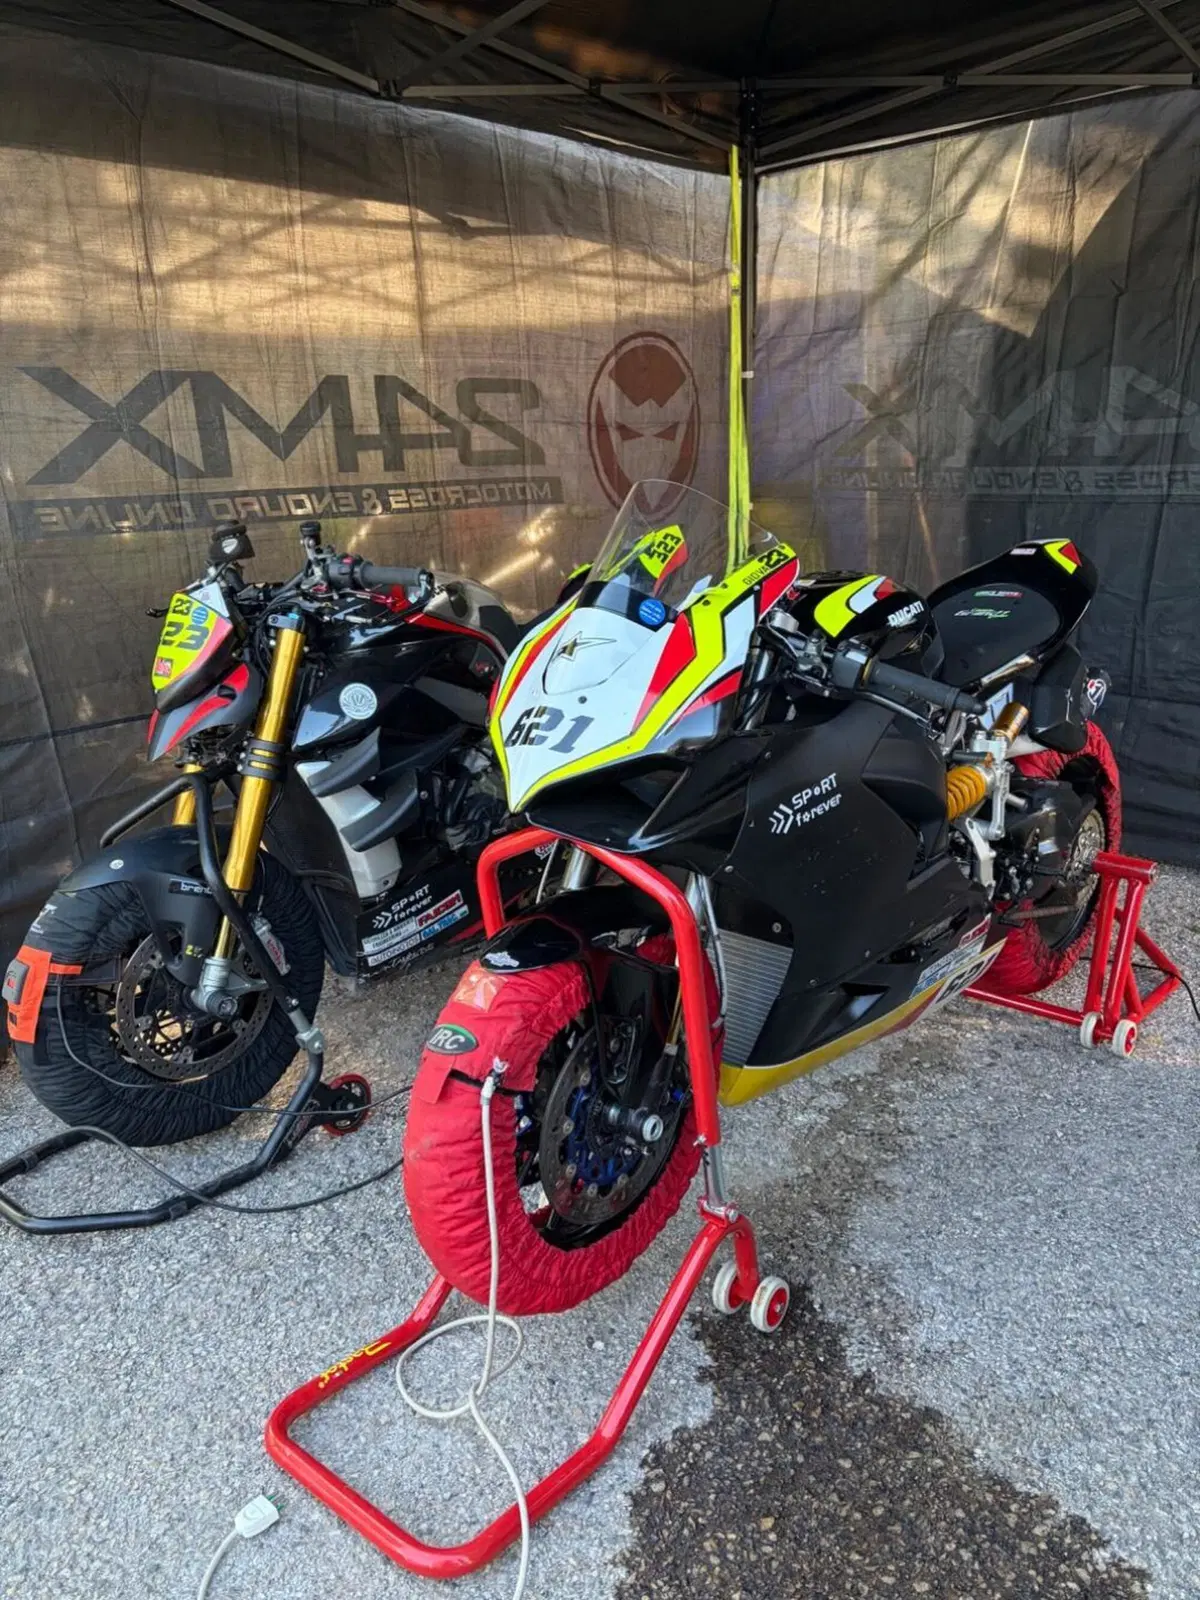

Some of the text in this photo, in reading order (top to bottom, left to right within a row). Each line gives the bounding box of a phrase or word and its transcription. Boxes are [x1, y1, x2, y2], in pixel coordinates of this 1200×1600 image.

[757, 549, 790, 568] 23
[172, 598, 193, 616] 23
[887, 601, 925, 627] DUCATI
[161, 621, 210, 651] 23
[504, 705, 595, 754] 621
[791, 772, 837, 810] SPORT
[796, 793, 842, 827] forever
[391, 884, 430, 912] SPORT
[394, 895, 433, 922] forever
